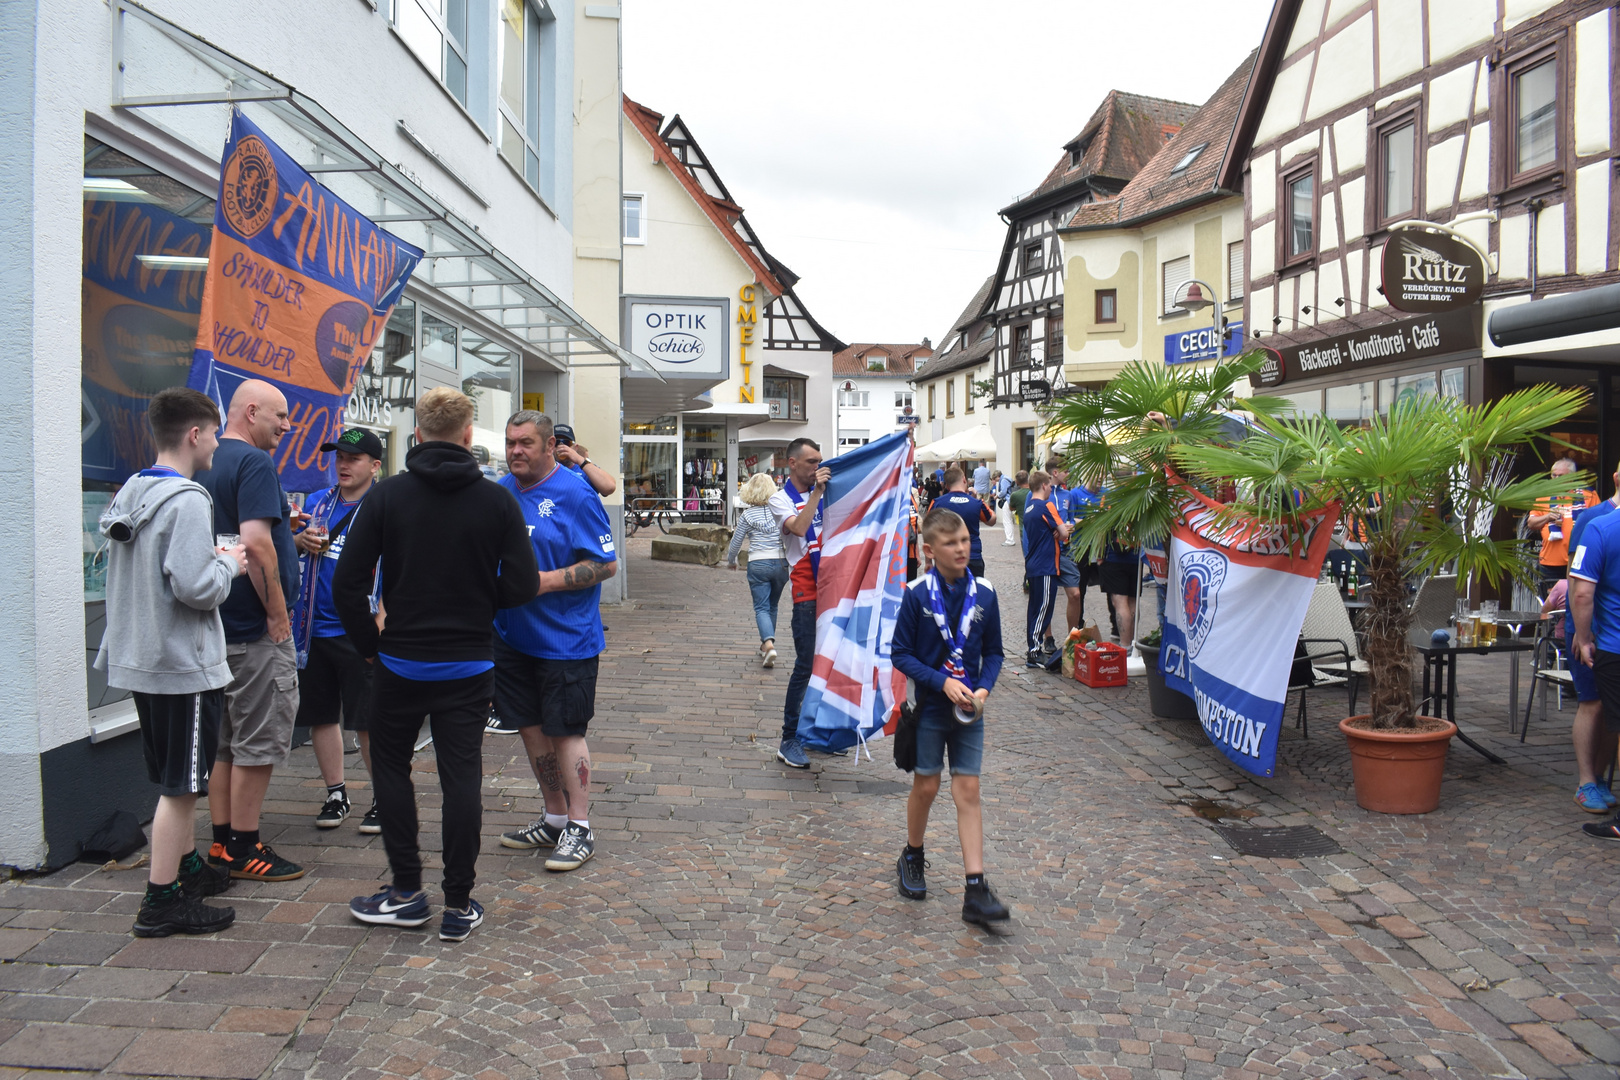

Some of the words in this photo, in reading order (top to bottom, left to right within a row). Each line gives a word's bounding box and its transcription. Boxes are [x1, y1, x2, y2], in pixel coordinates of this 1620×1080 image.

[272, 180, 396, 305] ANNAN
[1402, 284, 1443, 292] VERRÜCKT
[1430, 294, 1452, 302] BROT.
[251, 300, 269, 331] TO
[646, 313, 706, 330] OPTIK
[334, 321, 356, 348] The
[648, 337, 703, 354] Schick
[737, 284, 757, 403] GMELIN
[1299, 343, 1342, 371] Bäckerei
[1348, 329, 1406, 362] Konditorei
[1412, 321, 1440, 350] Café
[344, 394, 392, 426] ONA'S
